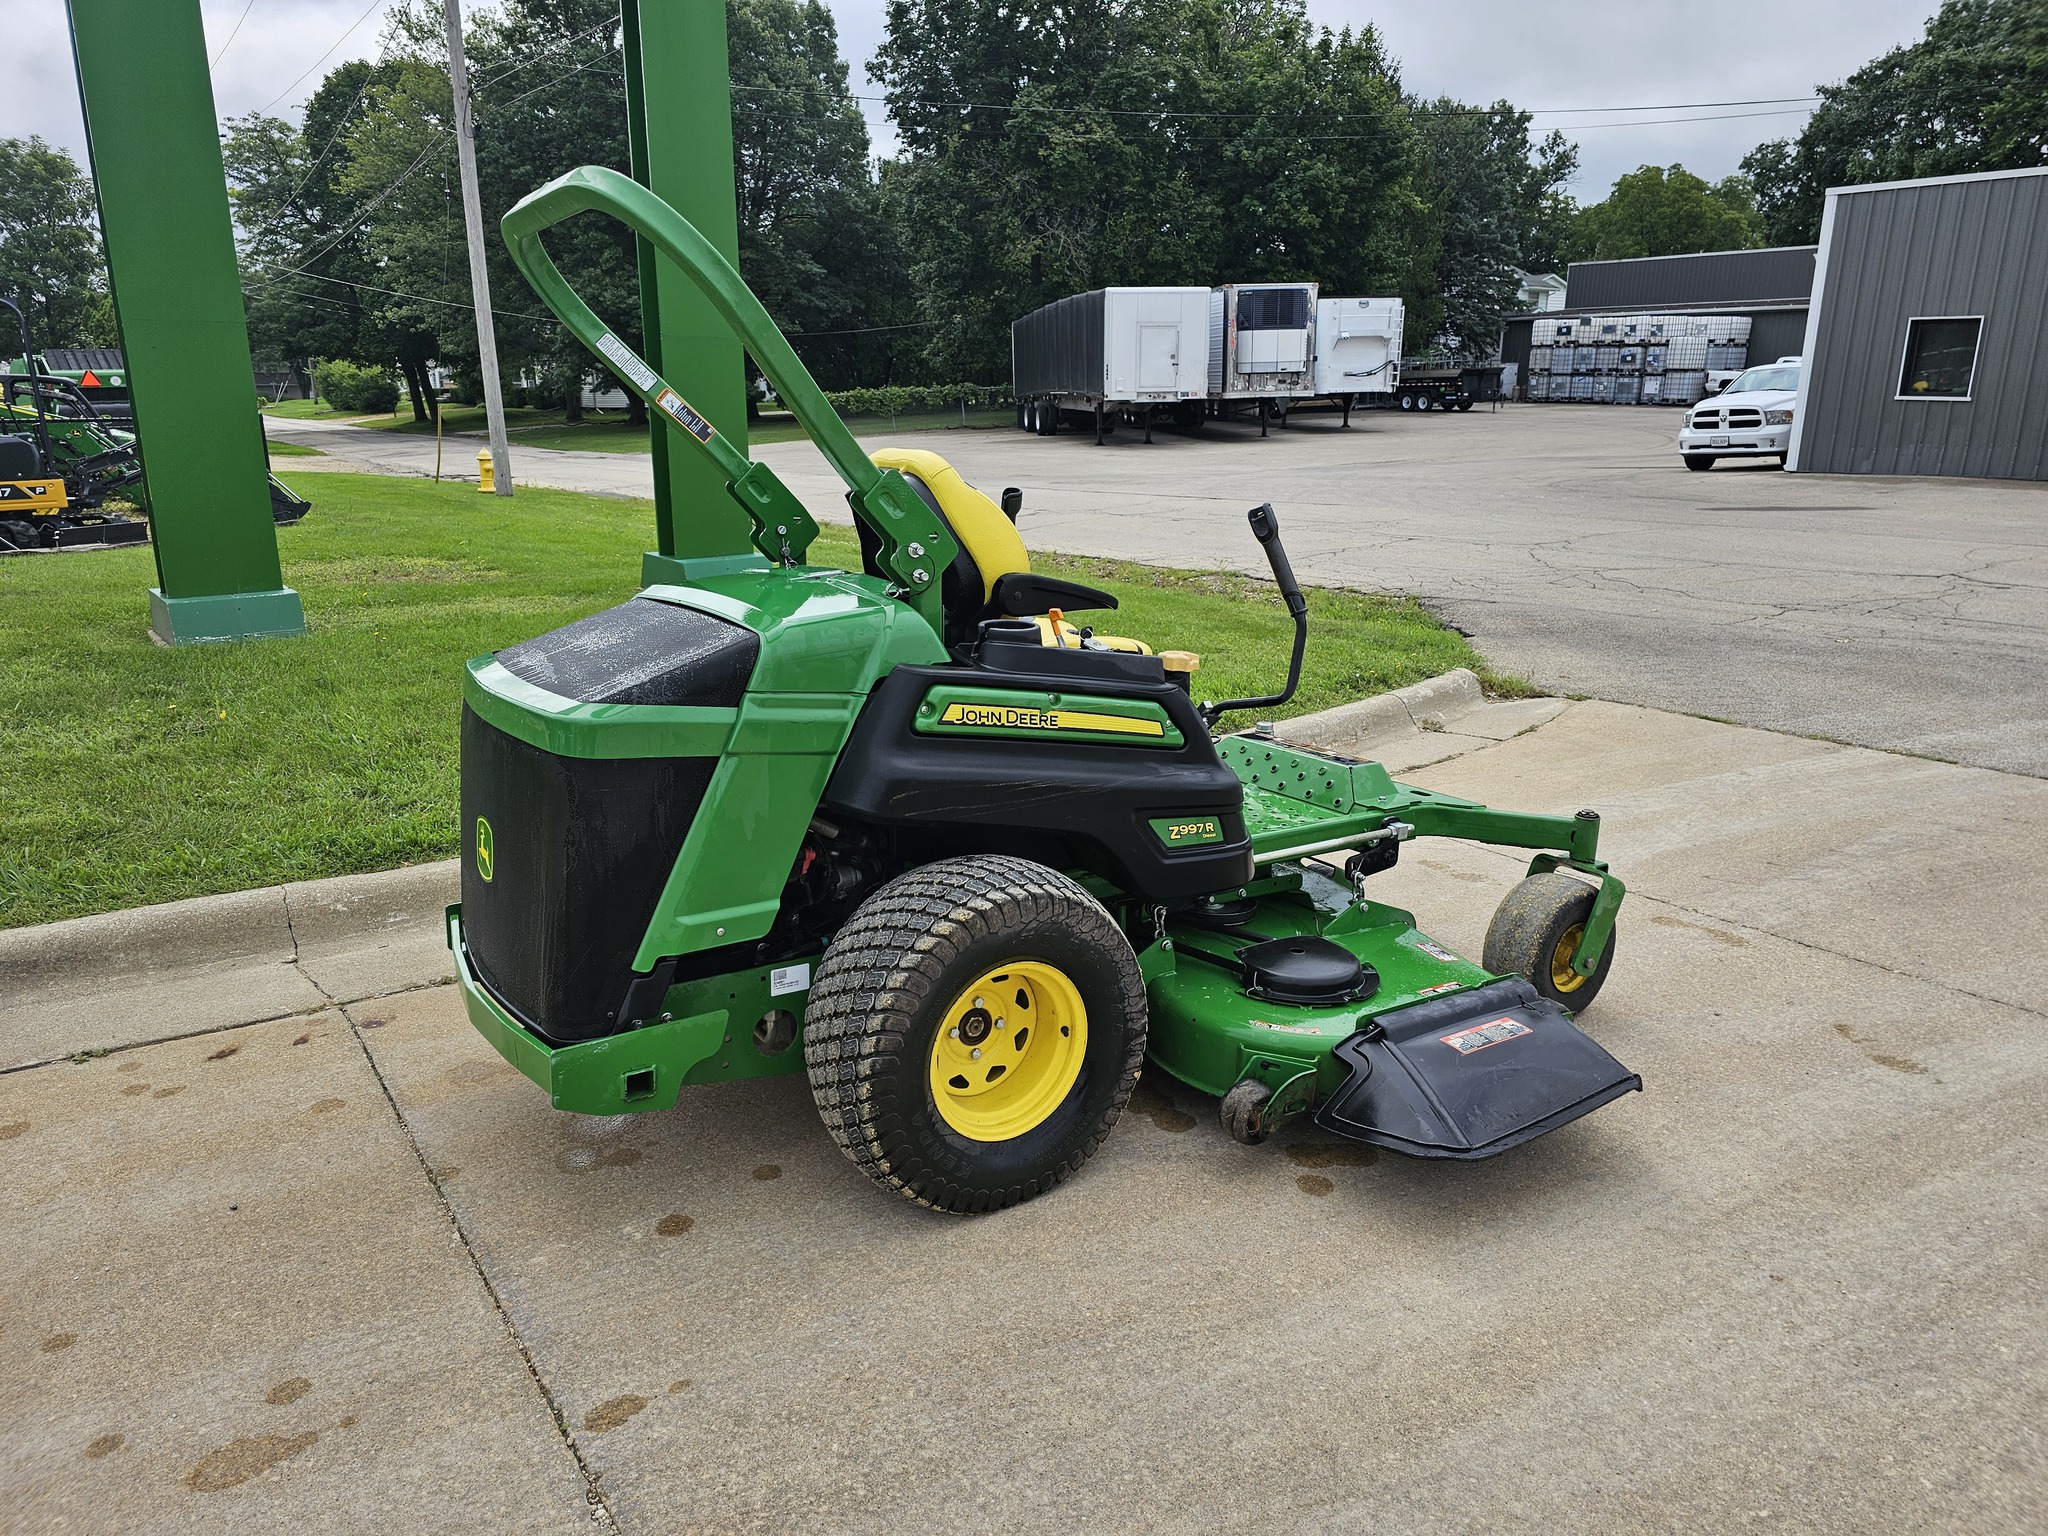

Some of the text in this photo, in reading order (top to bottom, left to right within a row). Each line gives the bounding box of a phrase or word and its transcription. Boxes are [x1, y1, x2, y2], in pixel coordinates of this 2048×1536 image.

[36, 487, 45, 495] P
[955, 707, 1059, 727] JOHN DEERE
[1168, 822, 1215, 840] Z997R
[911, 1111, 975, 1180] KENDA
